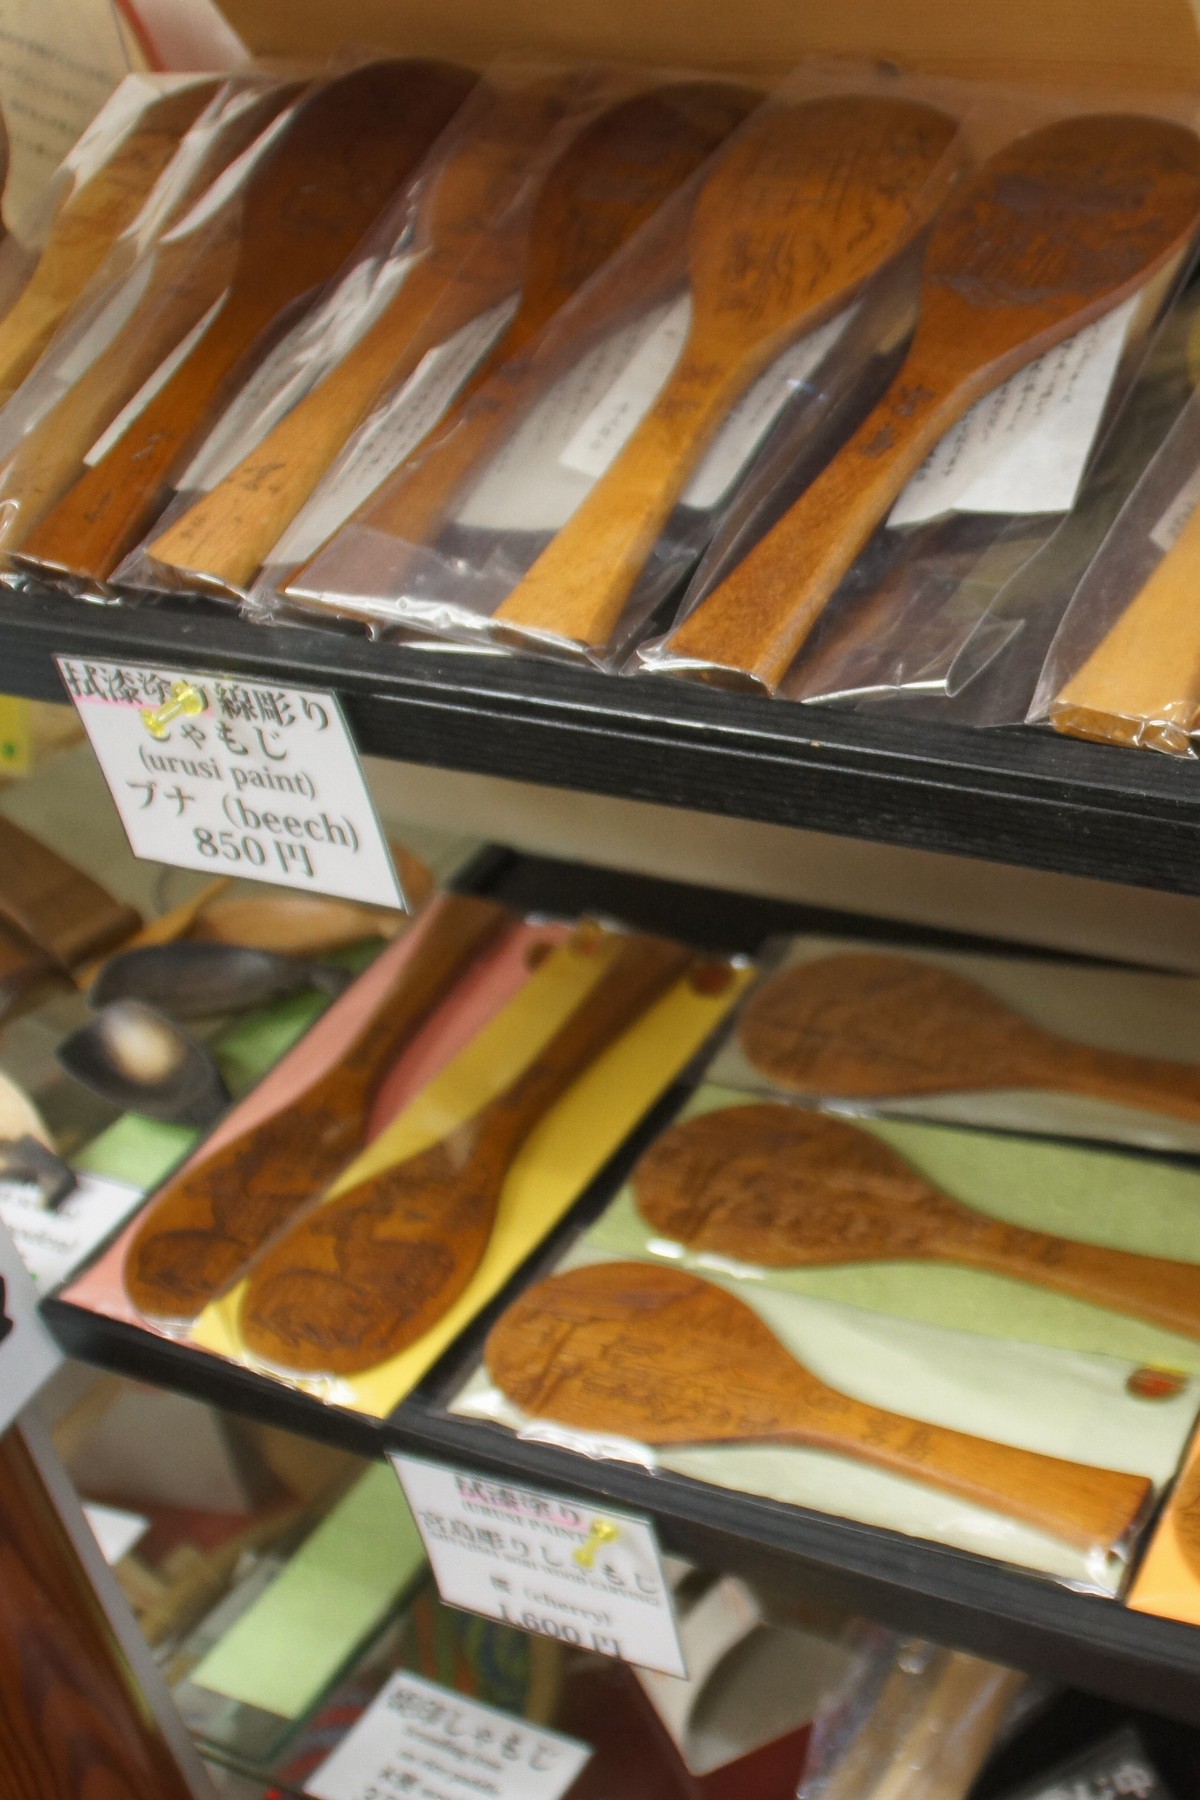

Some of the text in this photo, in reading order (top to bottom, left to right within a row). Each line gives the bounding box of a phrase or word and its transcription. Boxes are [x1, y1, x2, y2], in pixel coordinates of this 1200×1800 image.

[138, 745, 317, 801] (urusi paint)
[125, 779, 360, 855] ブナ (beech)
